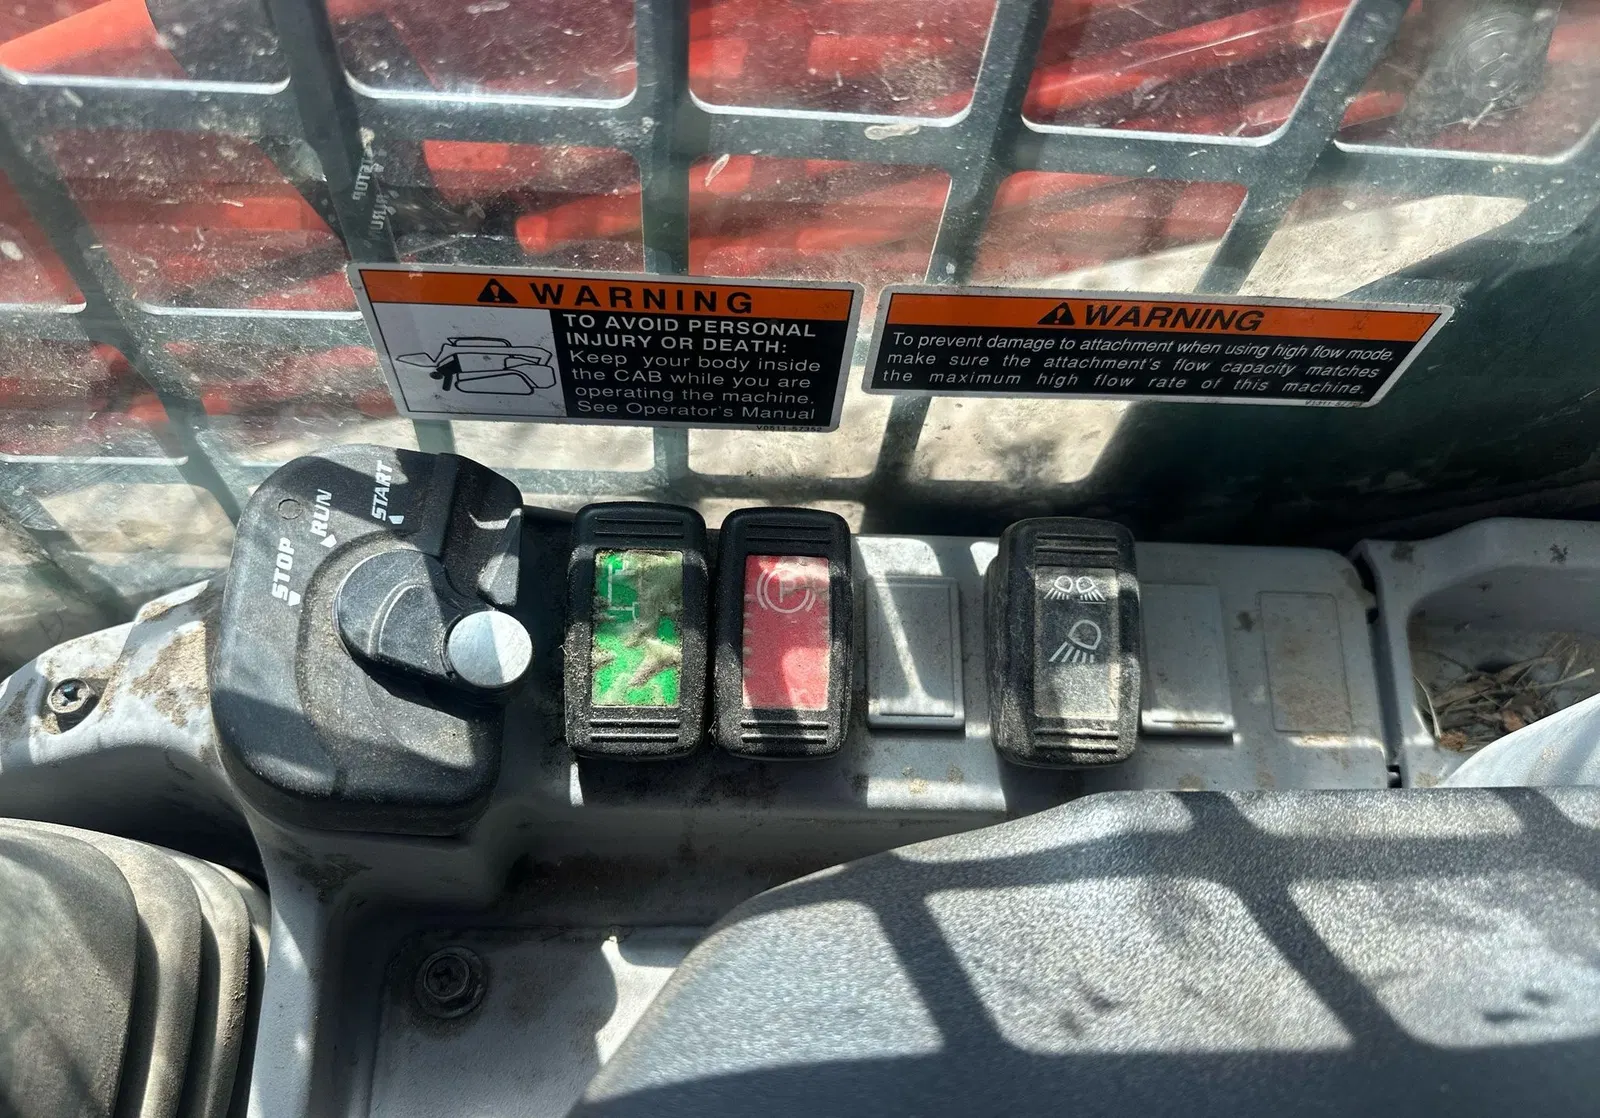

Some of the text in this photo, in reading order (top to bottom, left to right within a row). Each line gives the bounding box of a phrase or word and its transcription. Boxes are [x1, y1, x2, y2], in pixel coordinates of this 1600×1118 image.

[529, 282, 753, 314] WARNING
[562, 313, 816, 337] TO AVOID PERSONAL
[1085, 304, 1265, 332] WARNING
[566, 332, 787, 353] INJURY OR DEATH:
[893, 332, 1394, 362] To prevent damage to attachment when using high flow mode,
[570, 350, 821, 373] Keep your body inside
[887, 352, 1381, 379] make sure the attachment's flow capacity matches
[571, 368, 811, 389] the CAB while you are
[883, 369, 1365, 395] the maximum high flow rate of this machine.
[575, 387, 814, 405] operating the machine.
[578, 400, 815, 420] See Operator's Manual
[371, 459, 393, 522] START
[309, 488, 333, 538] RUN
[271, 536, 295, 601] STOP
